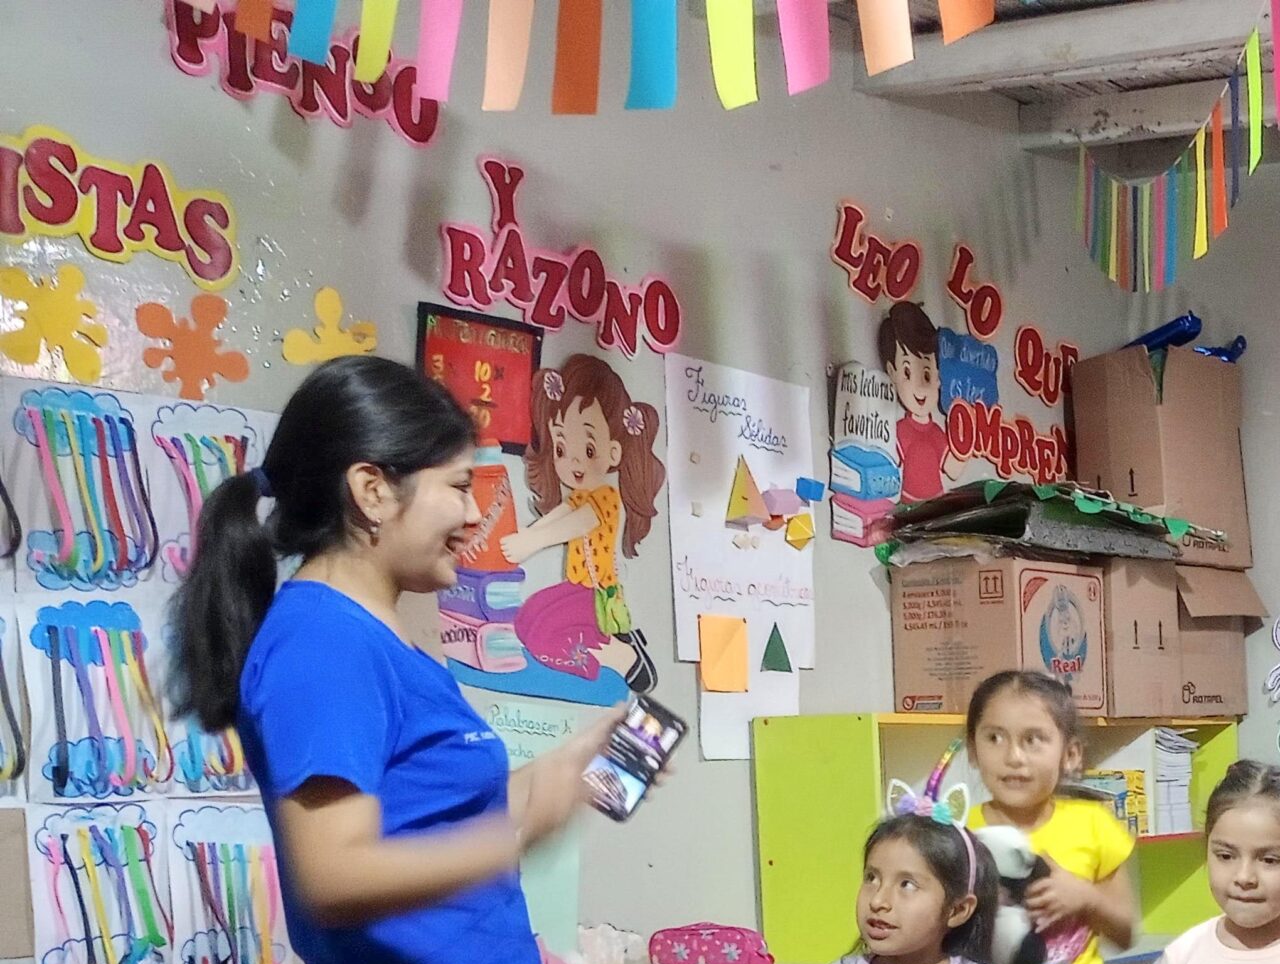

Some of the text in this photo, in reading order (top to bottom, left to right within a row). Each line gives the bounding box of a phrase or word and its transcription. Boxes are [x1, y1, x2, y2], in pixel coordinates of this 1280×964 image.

[484, 160, 525, 230] Y
[446, 227, 681, 354] RAZONO
[834, 204, 921, 302] LEO
[948, 245, 1003, 337] LO
[480, 383, 493, 402] 2
[684, 366, 747, 424] Figuras
[860, 368, 895, 403] lecturas
[842, 401, 890, 443] favoritas
[1052, 656, 1084, 674] Real
